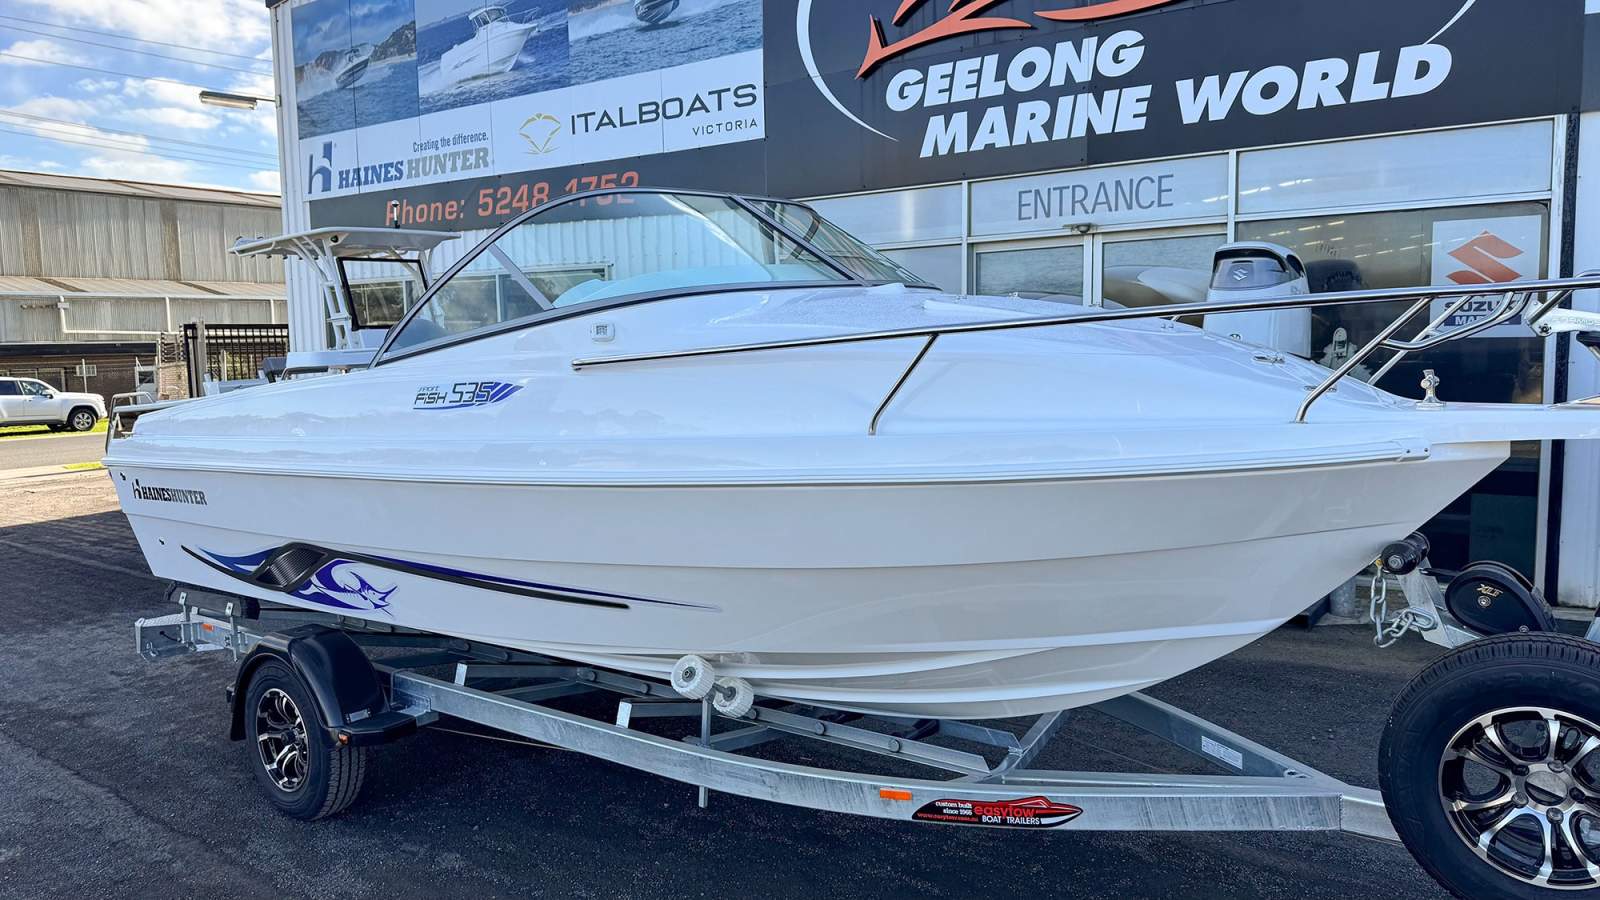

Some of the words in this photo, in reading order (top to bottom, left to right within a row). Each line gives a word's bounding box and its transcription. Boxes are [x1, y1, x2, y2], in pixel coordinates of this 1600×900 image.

[886, 30, 1145, 111] GEELONG
[571, 84, 757, 135] ITALBOATS
[920, 85, 1152, 158] MARINE
[1175, 43, 1453, 125] WORLD
[413, 139, 439, 153] Creating
[440, 136, 451, 148] the
[452, 131, 489, 147] difference.
[692, 118, 758, 136] VICTORIA
[338, 160, 404, 190] HAINES
[406, 147, 489, 180] HUNTER
[385, 198, 465, 227] Phone:
[478, 182, 550, 217] 5248
[1018, 174, 1174, 221] ENTRANCE
[449, 381, 495, 404] 535
[981, 814, 1002, 824] BOAT
[1006, 815, 1040, 825] TRAILERS
